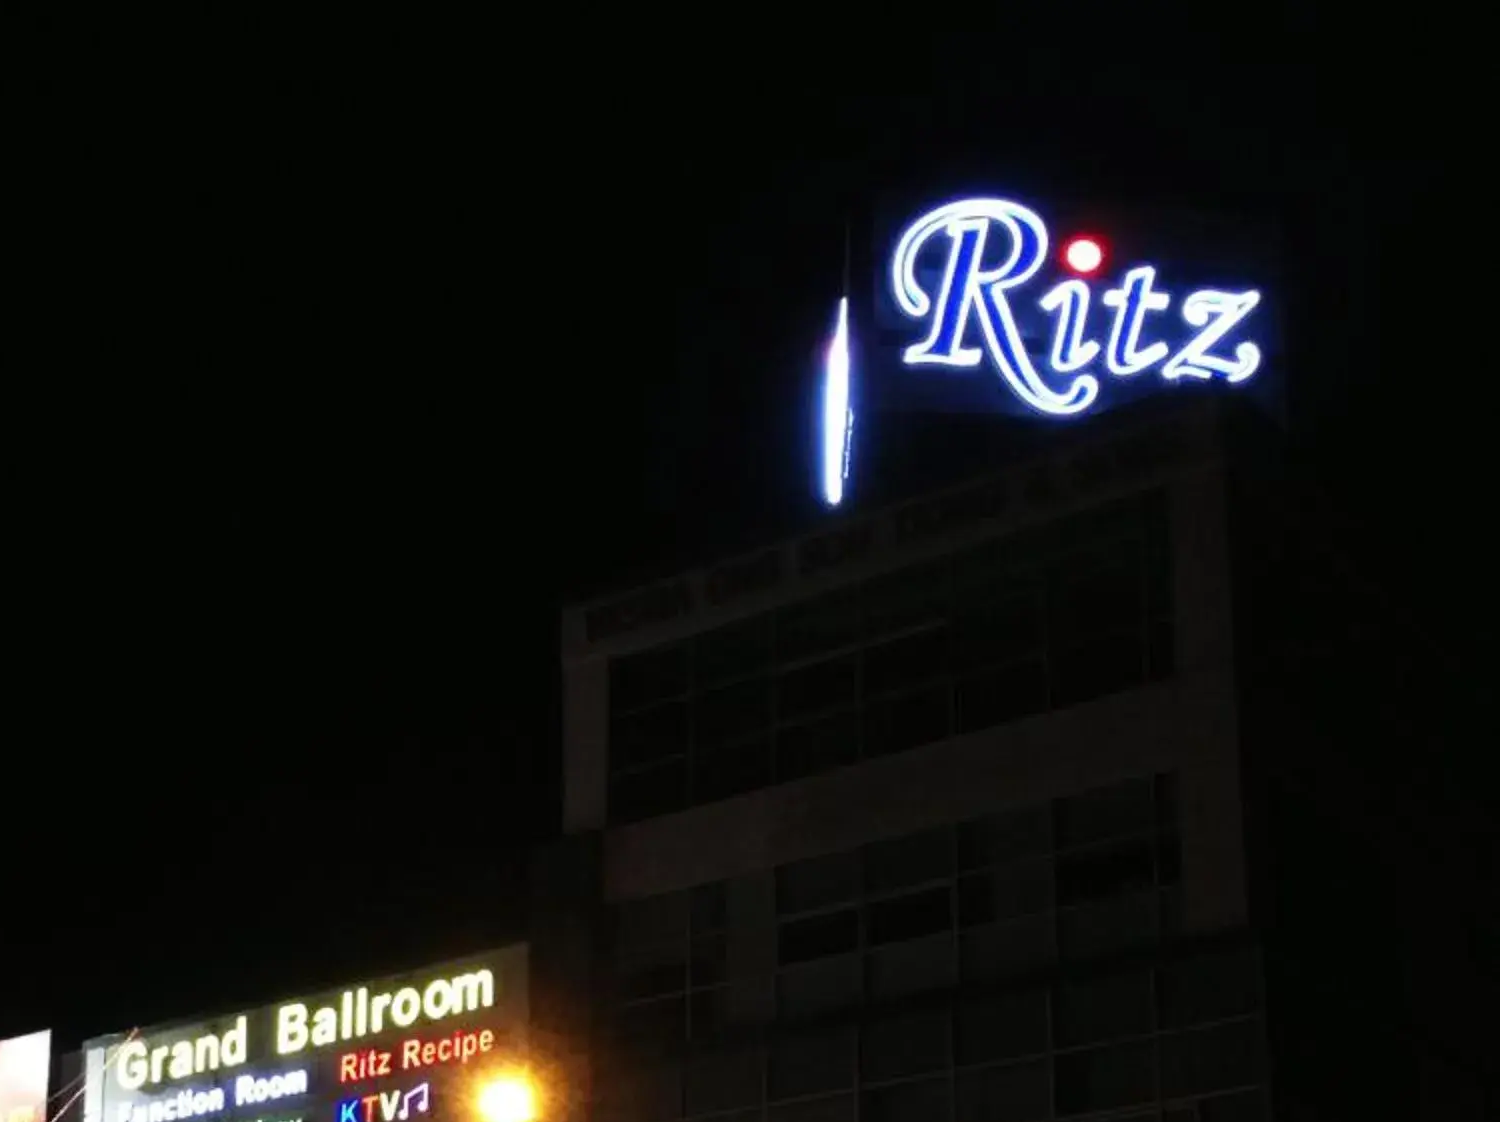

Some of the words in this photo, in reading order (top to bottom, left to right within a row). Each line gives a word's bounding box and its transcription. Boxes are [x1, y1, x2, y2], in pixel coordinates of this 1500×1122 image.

[893, 198, 1260, 415] Ritz
[116, 1015, 247, 1091] Grand
[276, 967, 495, 1055] Ballroom
[340, 1050, 392, 1084] Ritz
[402, 1027, 495, 1071] Recipe
[235, 1068, 308, 1107] Room
